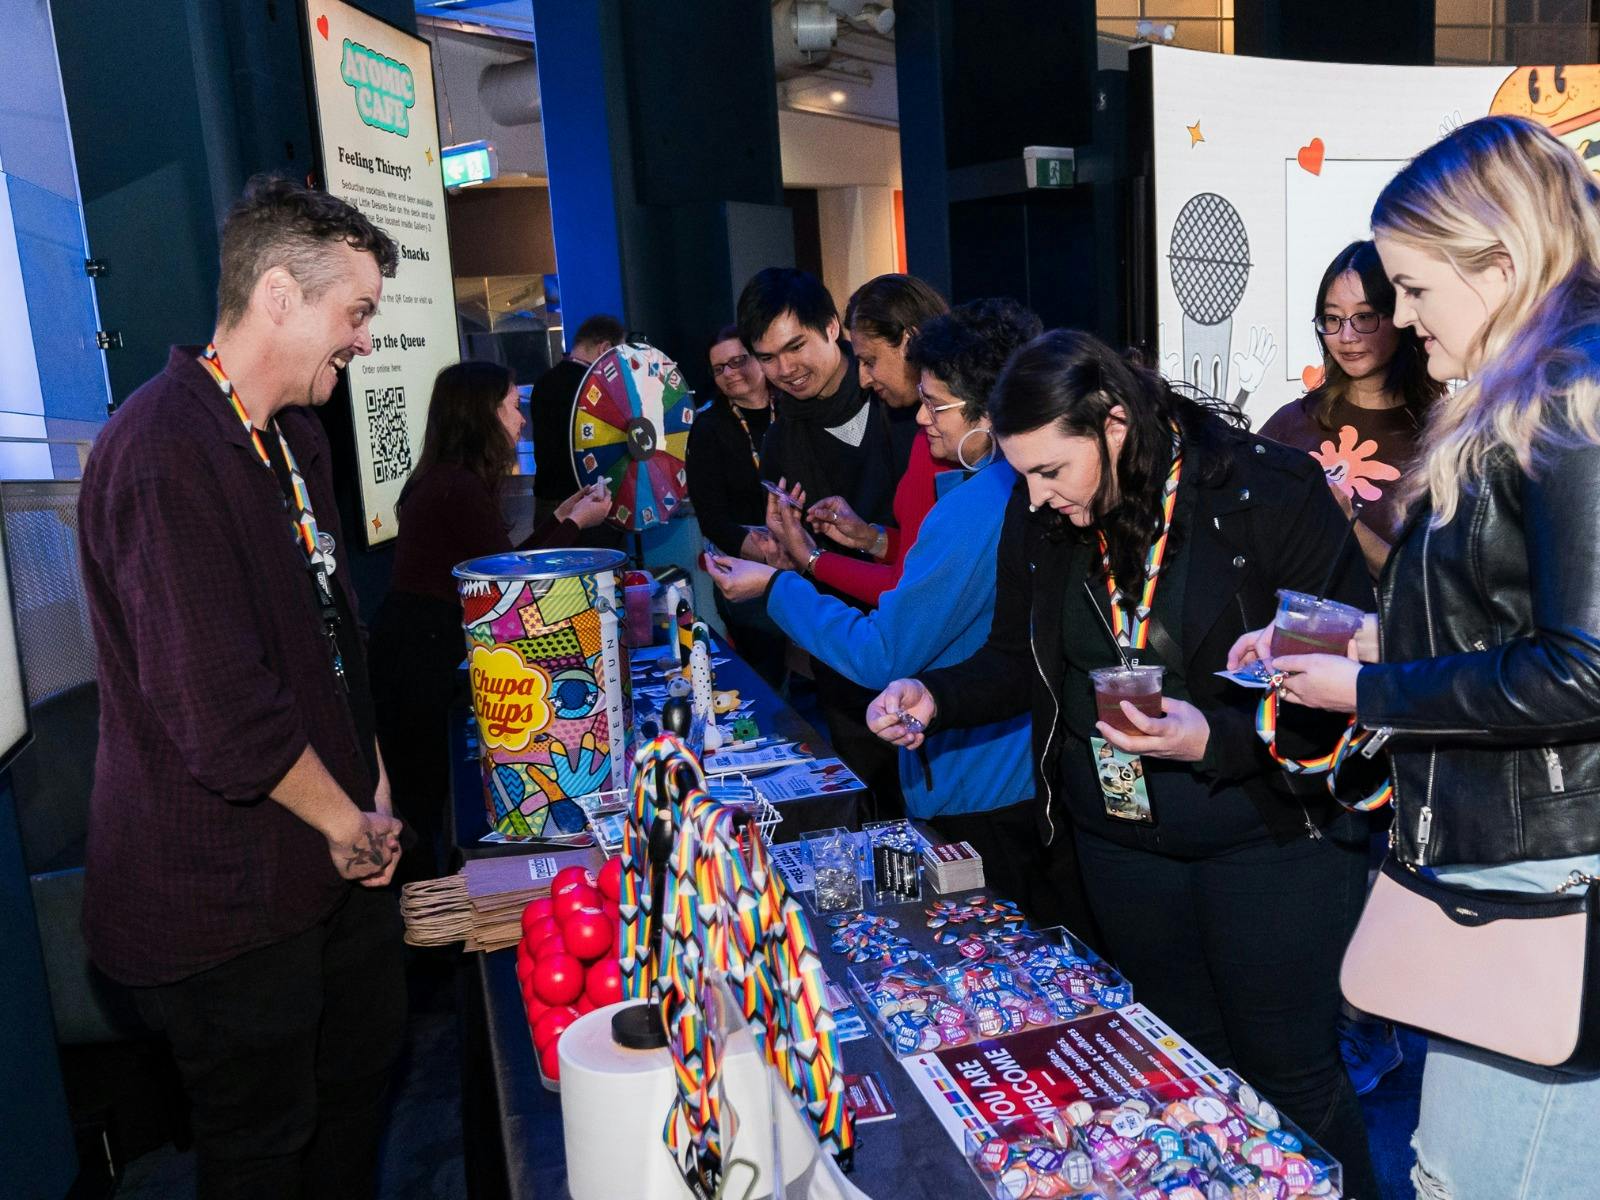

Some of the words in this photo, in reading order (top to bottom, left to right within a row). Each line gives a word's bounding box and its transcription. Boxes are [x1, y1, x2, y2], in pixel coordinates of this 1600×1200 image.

[345, 46, 413, 100] ATOMIC
[338, 146, 374, 174] Feeling
[375, 157, 412, 181] Thirsty?
[341, 179, 365, 192] Seductive
[359, 197, 371, 208] Little
[372, 200, 388, 212] Desires
[401, 244, 430, 261] Snacks
[395, 293, 402, 305] QR
[402, 294, 413, 304] Code
[372, 334, 382, 352] ip
[383, 334, 398, 348] the
[400, 333, 426, 351] Queue
[362, 364, 375, 375] Order
[377, 364, 390, 374] online
[606, 640, 617, 684] FUN
[473, 667, 535, 702] Chupa
[475, 692, 533, 737] Chups
[776, 850, 797, 868] LEGAL
[788, 867, 807, 884] FREE
[1070, 978, 1084, 986] SHE
[1071, 986, 1085, 996] HER
[900, 1026, 917, 1038] THEY
[979, 1019, 999, 1032] THEY
[899, 1035, 915, 1048] THEM
[1066, 1028, 1098, 1056] cultures
[955, 1059, 998, 1088] ARE
[1113, 1052, 1151, 1087] welcome
[983, 1047, 1057, 1125] WELCOME
[1079, 1086, 1098, 1098] All
[1089, 1069, 1127, 1103] genders,
[980, 1090, 1024, 1127] YOU
